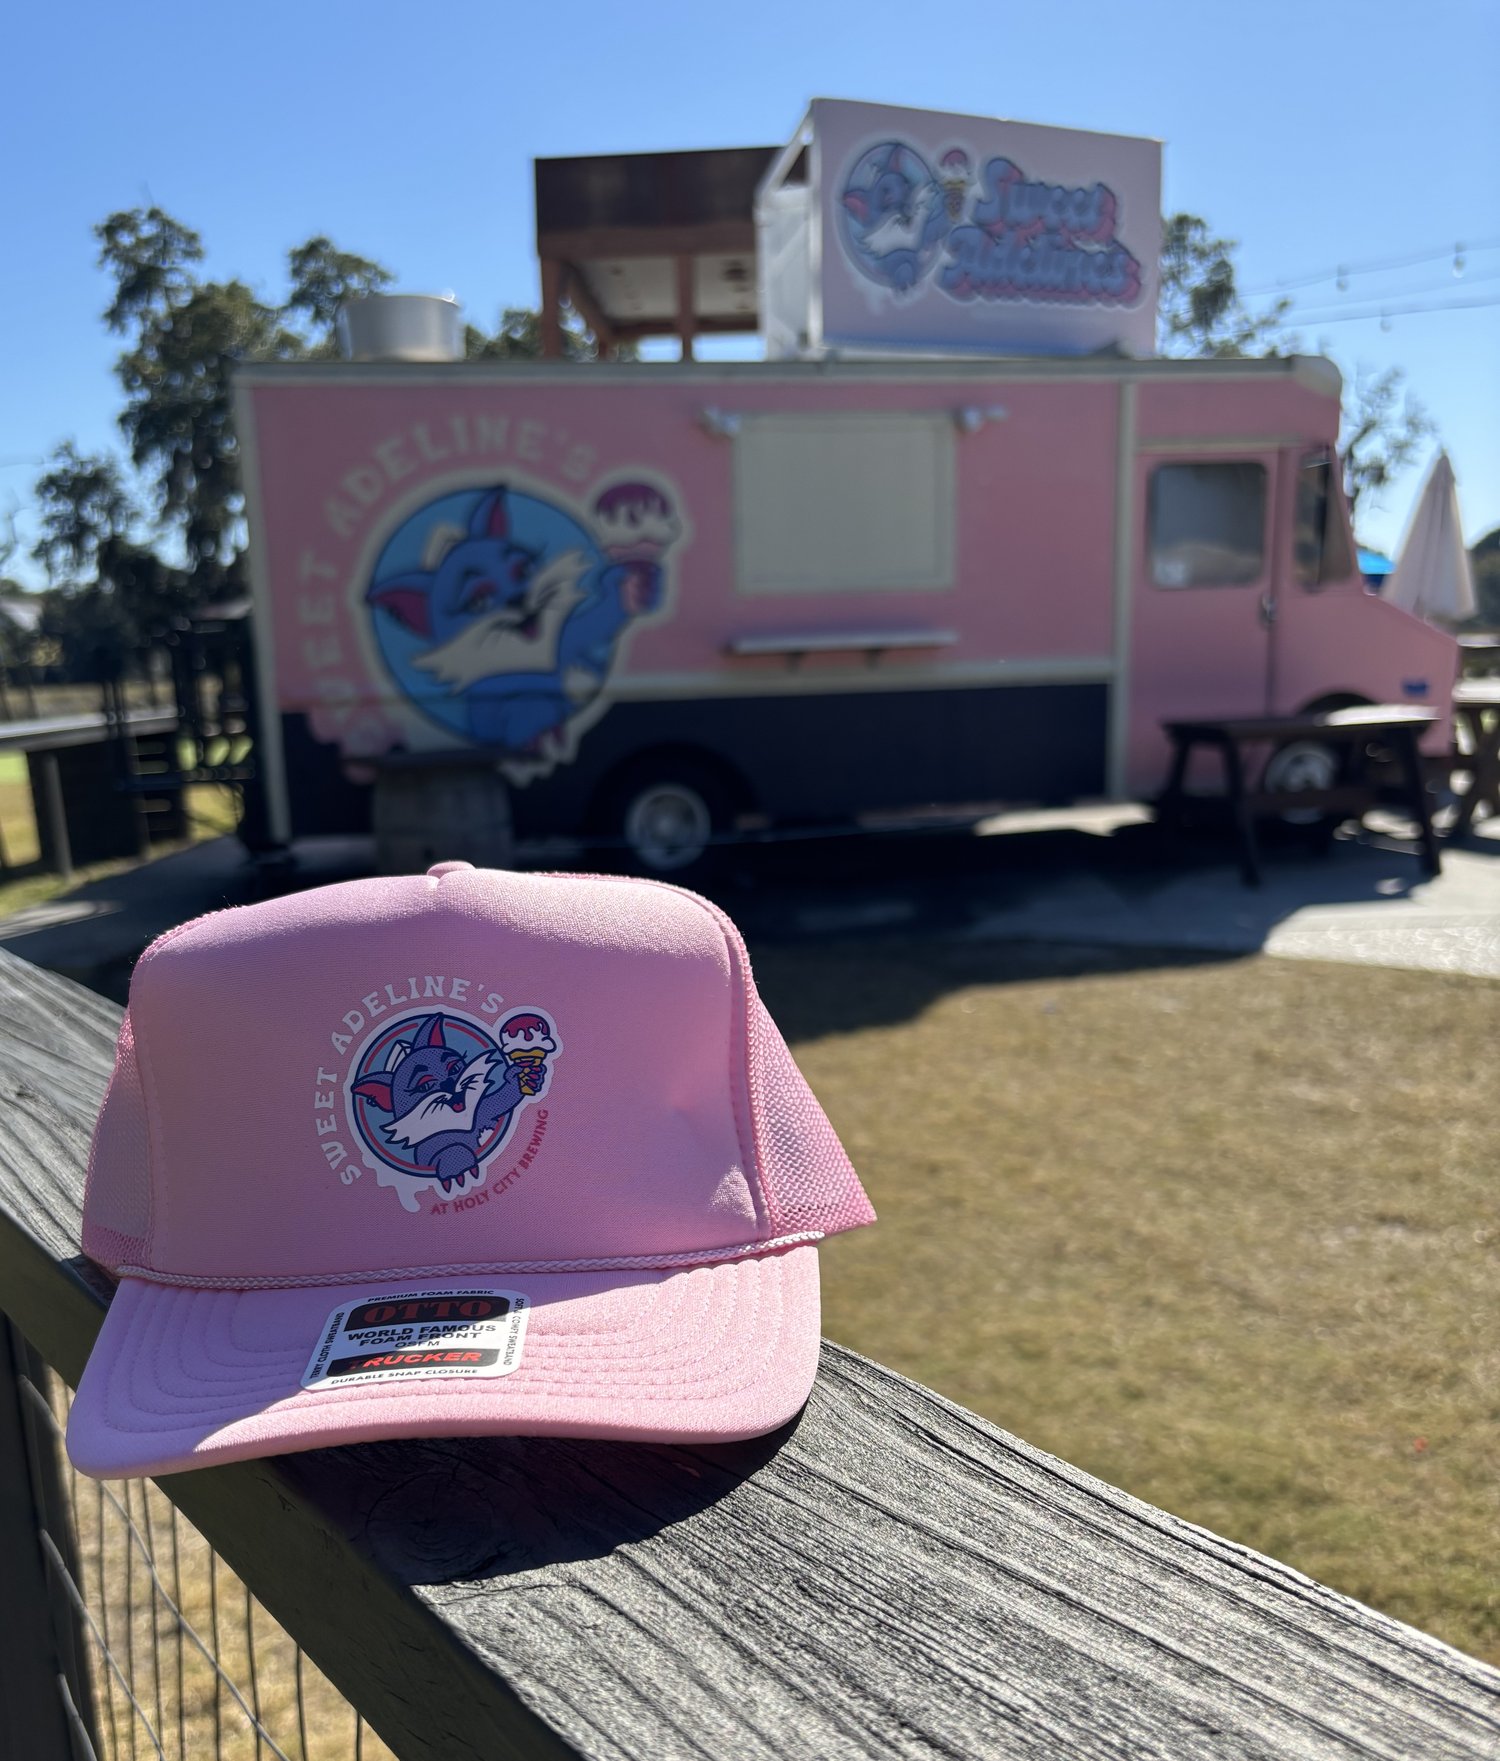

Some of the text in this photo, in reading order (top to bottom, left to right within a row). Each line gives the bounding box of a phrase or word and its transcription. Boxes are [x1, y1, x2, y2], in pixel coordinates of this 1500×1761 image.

[324, 413, 600, 541] ADELINE'S
[314, 975, 504, 1185] SWEET ADELINE'S
[430, 1109, 549, 1215] AT HOLY CITY BREWING
[367, 1292, 418, 1303] PREMIUM
[363, 1300, 492, 1323] OTTO
[317, 1344, 332, 1363] CLOTH
[325, 1311, 345, 1344] SWEATBAND
[348, 1324, 497, 1341] WORLD FAMOUS
[358, 1331, 482, 1347] FOAM FRONT
[394, 1340, 441, 1348] OSFM
[503, 1335, 518, 1366] SWEATBAND
[330, 1373, 384, 1385] DURABLE
[388, 1370, 422, 1378] SNAP
